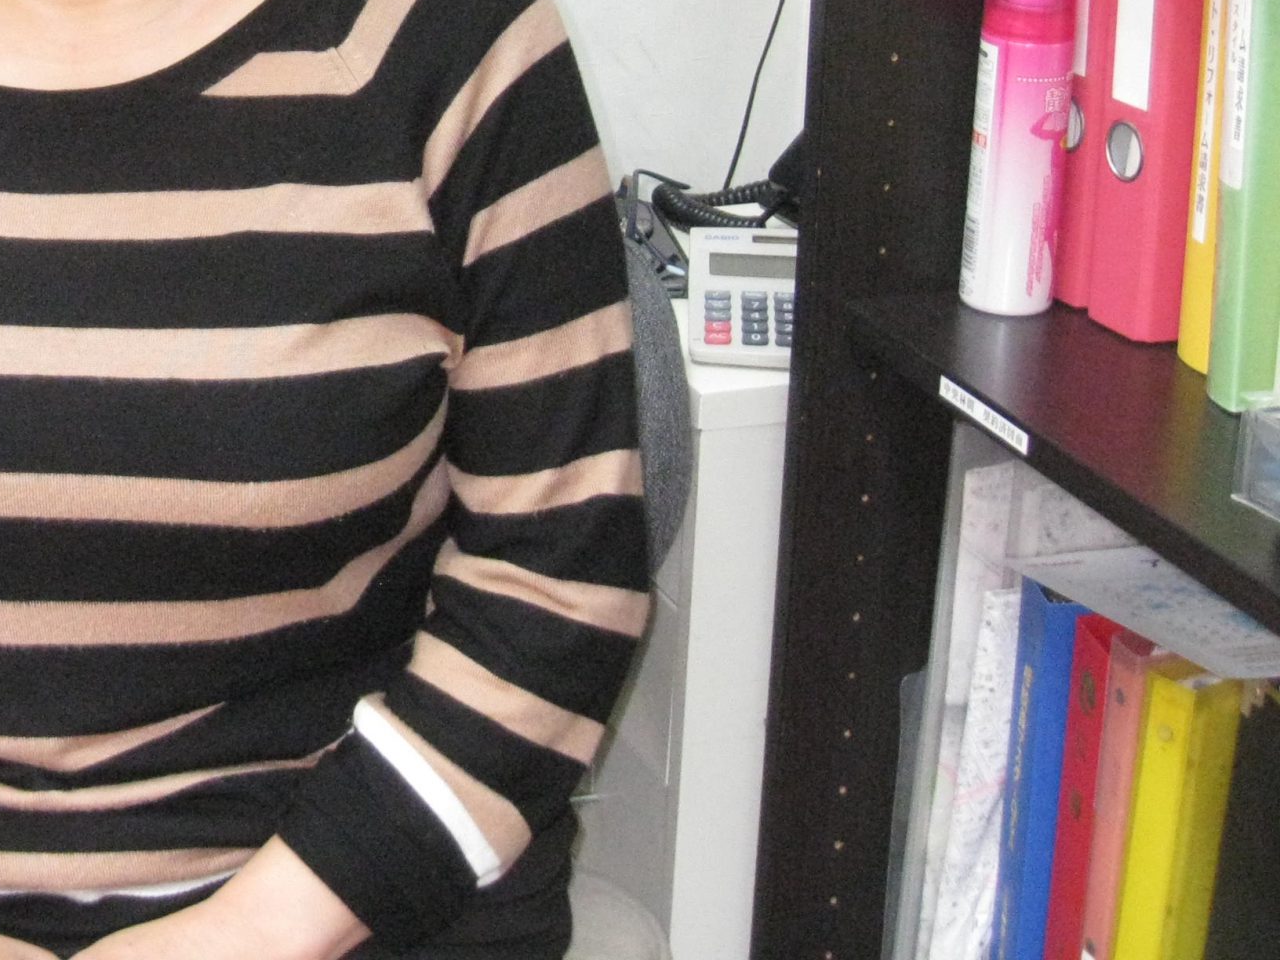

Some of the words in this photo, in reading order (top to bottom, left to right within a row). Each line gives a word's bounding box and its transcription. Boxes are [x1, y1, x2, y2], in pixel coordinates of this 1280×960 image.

[751, 301, 760, 309] 7
[750, 311, 760, 319] 4
[751, 333, 761, 341] 0
